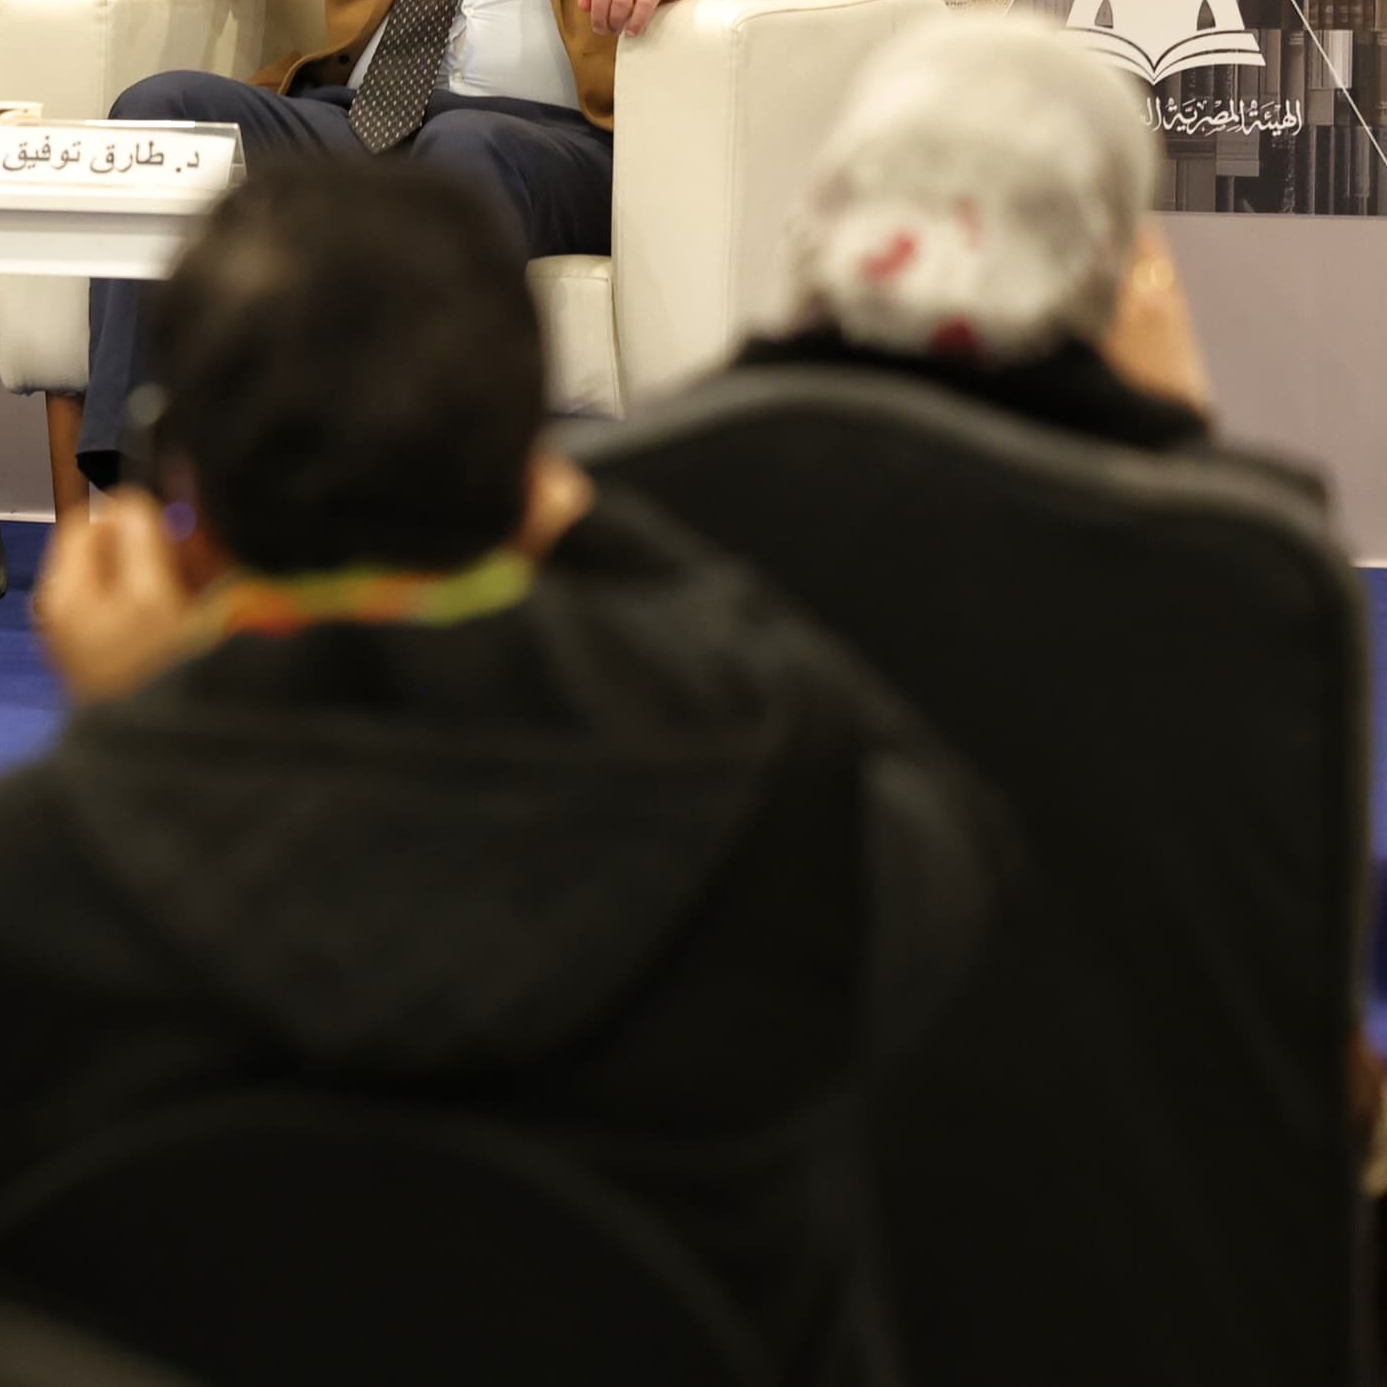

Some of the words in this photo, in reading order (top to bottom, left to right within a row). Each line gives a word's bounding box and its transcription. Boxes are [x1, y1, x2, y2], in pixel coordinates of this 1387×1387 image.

[1162, 97, 1245, 136] المصرية
[1240, 99, 1304, 135] الهيئة
[1, 135, 82, 172] توفيق
[89, 139, 165, 173] طارق
